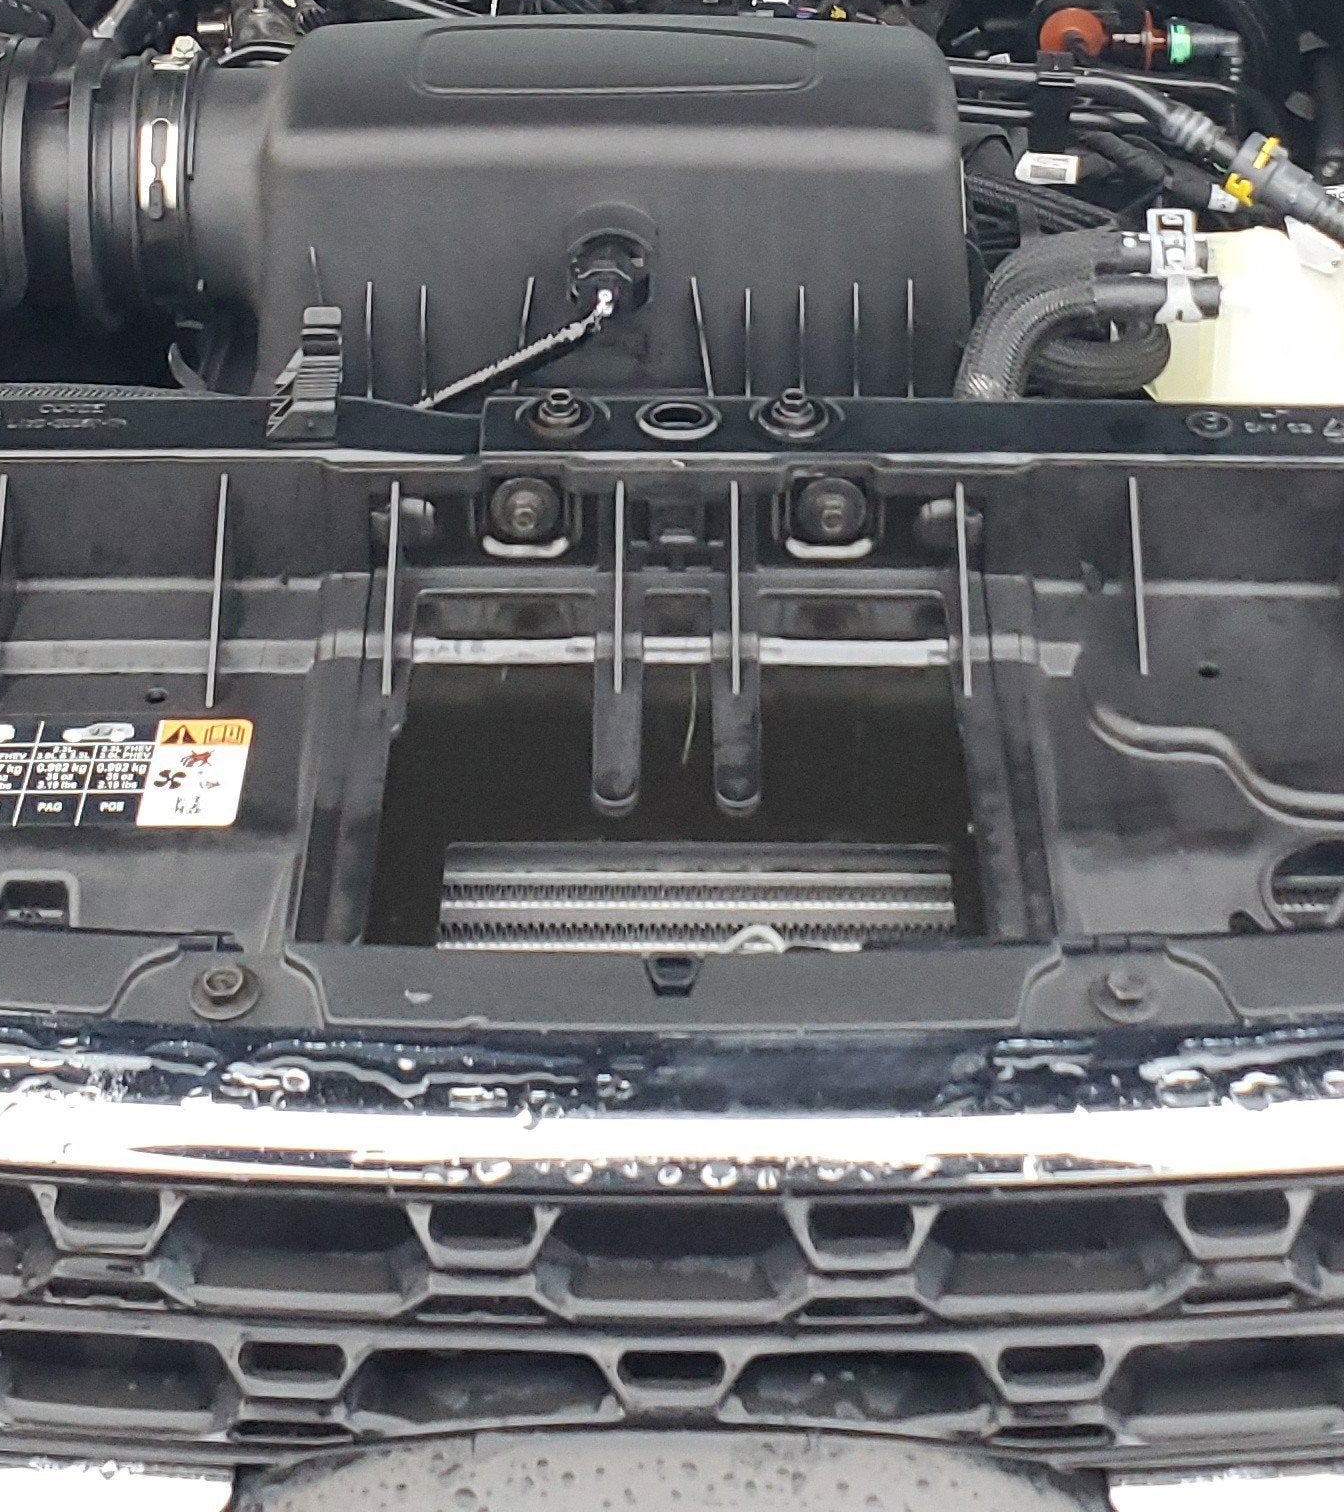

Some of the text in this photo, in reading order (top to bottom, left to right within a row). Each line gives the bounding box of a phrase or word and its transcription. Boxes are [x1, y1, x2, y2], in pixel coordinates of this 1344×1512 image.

[6, 764, 23, 776] kg
[71, 763, 88, 775] kg
[131, 763, 147, 775] kg
[37, 801, 63, 812] PAG
